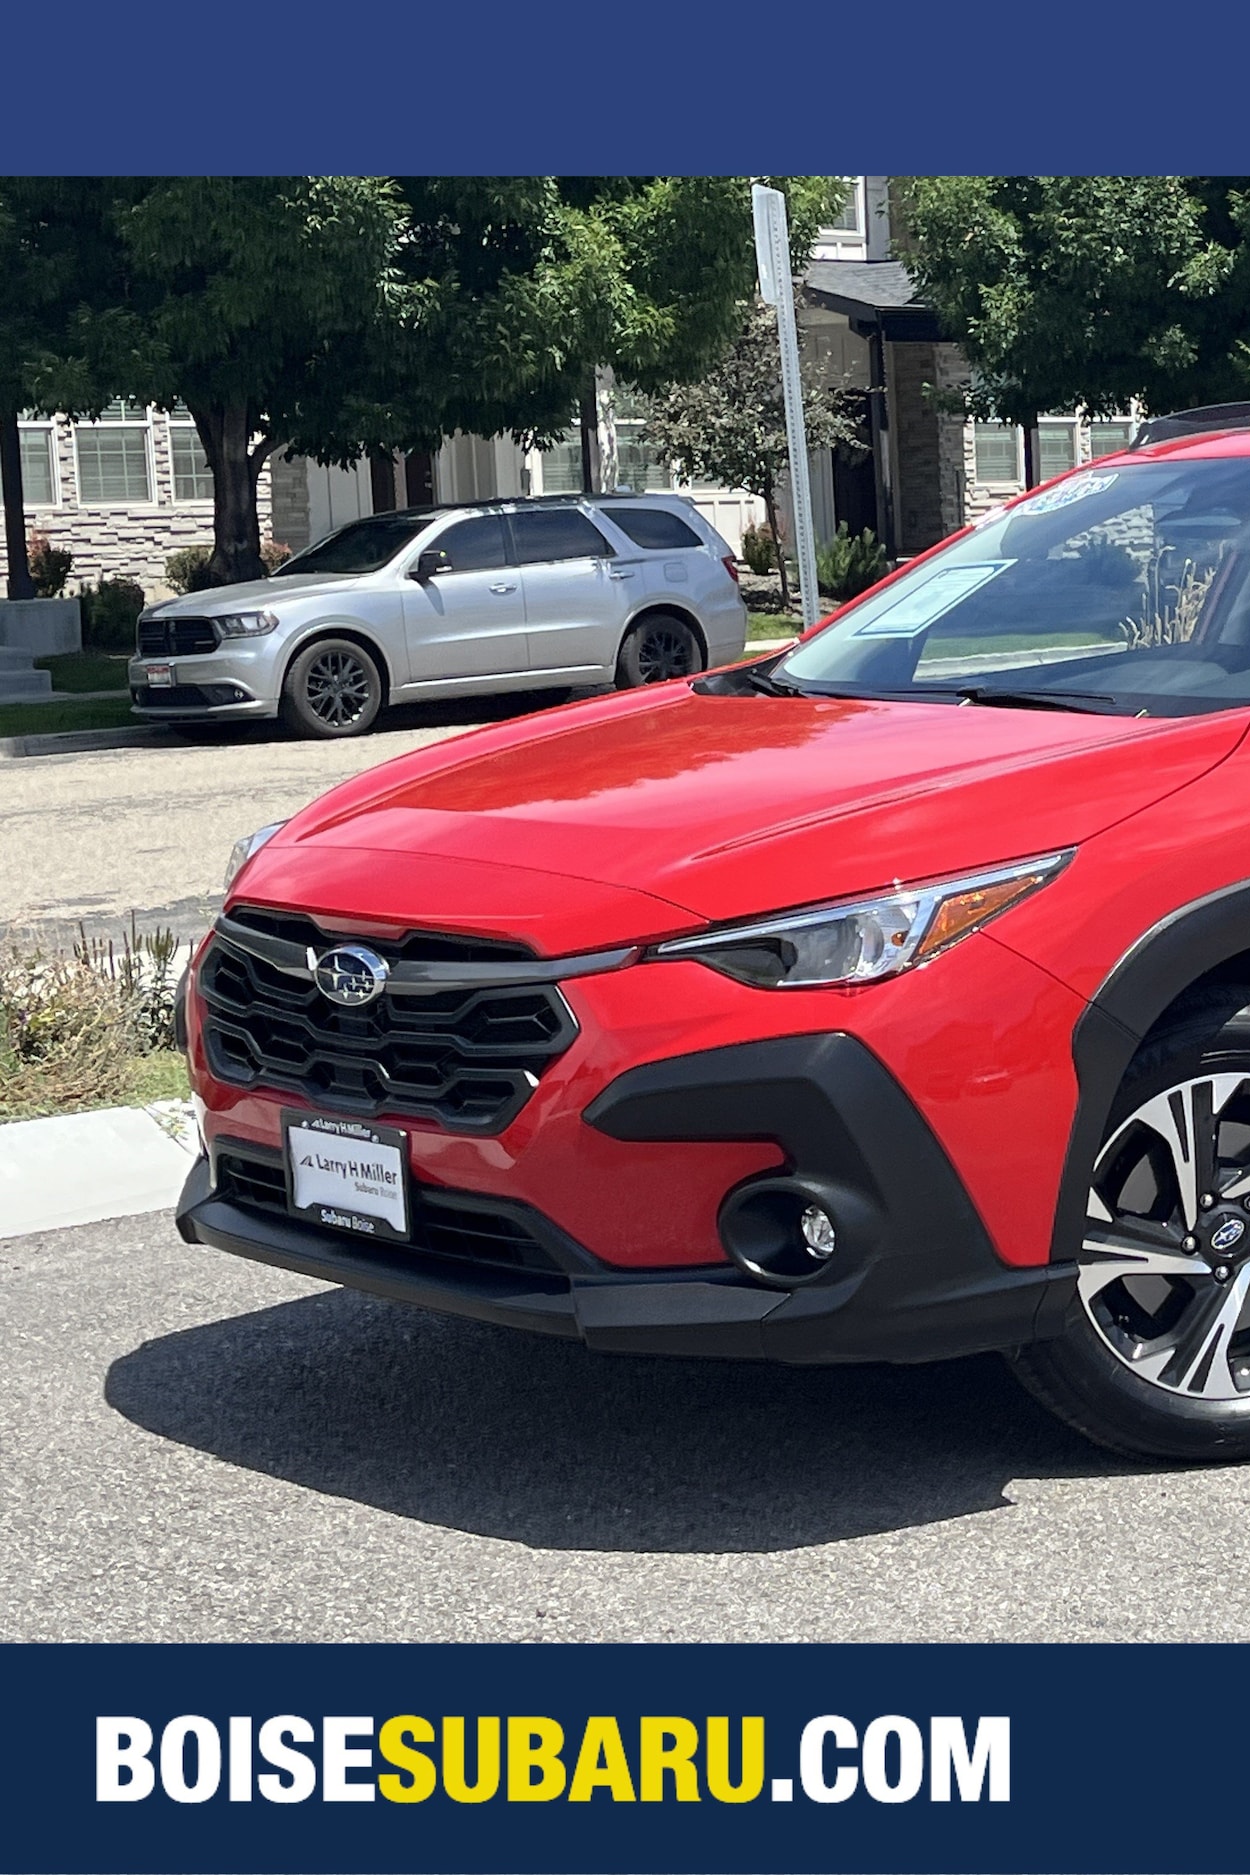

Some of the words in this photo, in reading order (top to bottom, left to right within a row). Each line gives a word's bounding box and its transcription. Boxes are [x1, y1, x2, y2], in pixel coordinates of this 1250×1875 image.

[315, 1154, 347, 1180] Larry
[348, 1160, 359, 1177] H
[360, 1162, 398, 1185] Miller
[320, 1208, 352, 1229] Subaru
[351, 1214, 375, 1233] Boise
